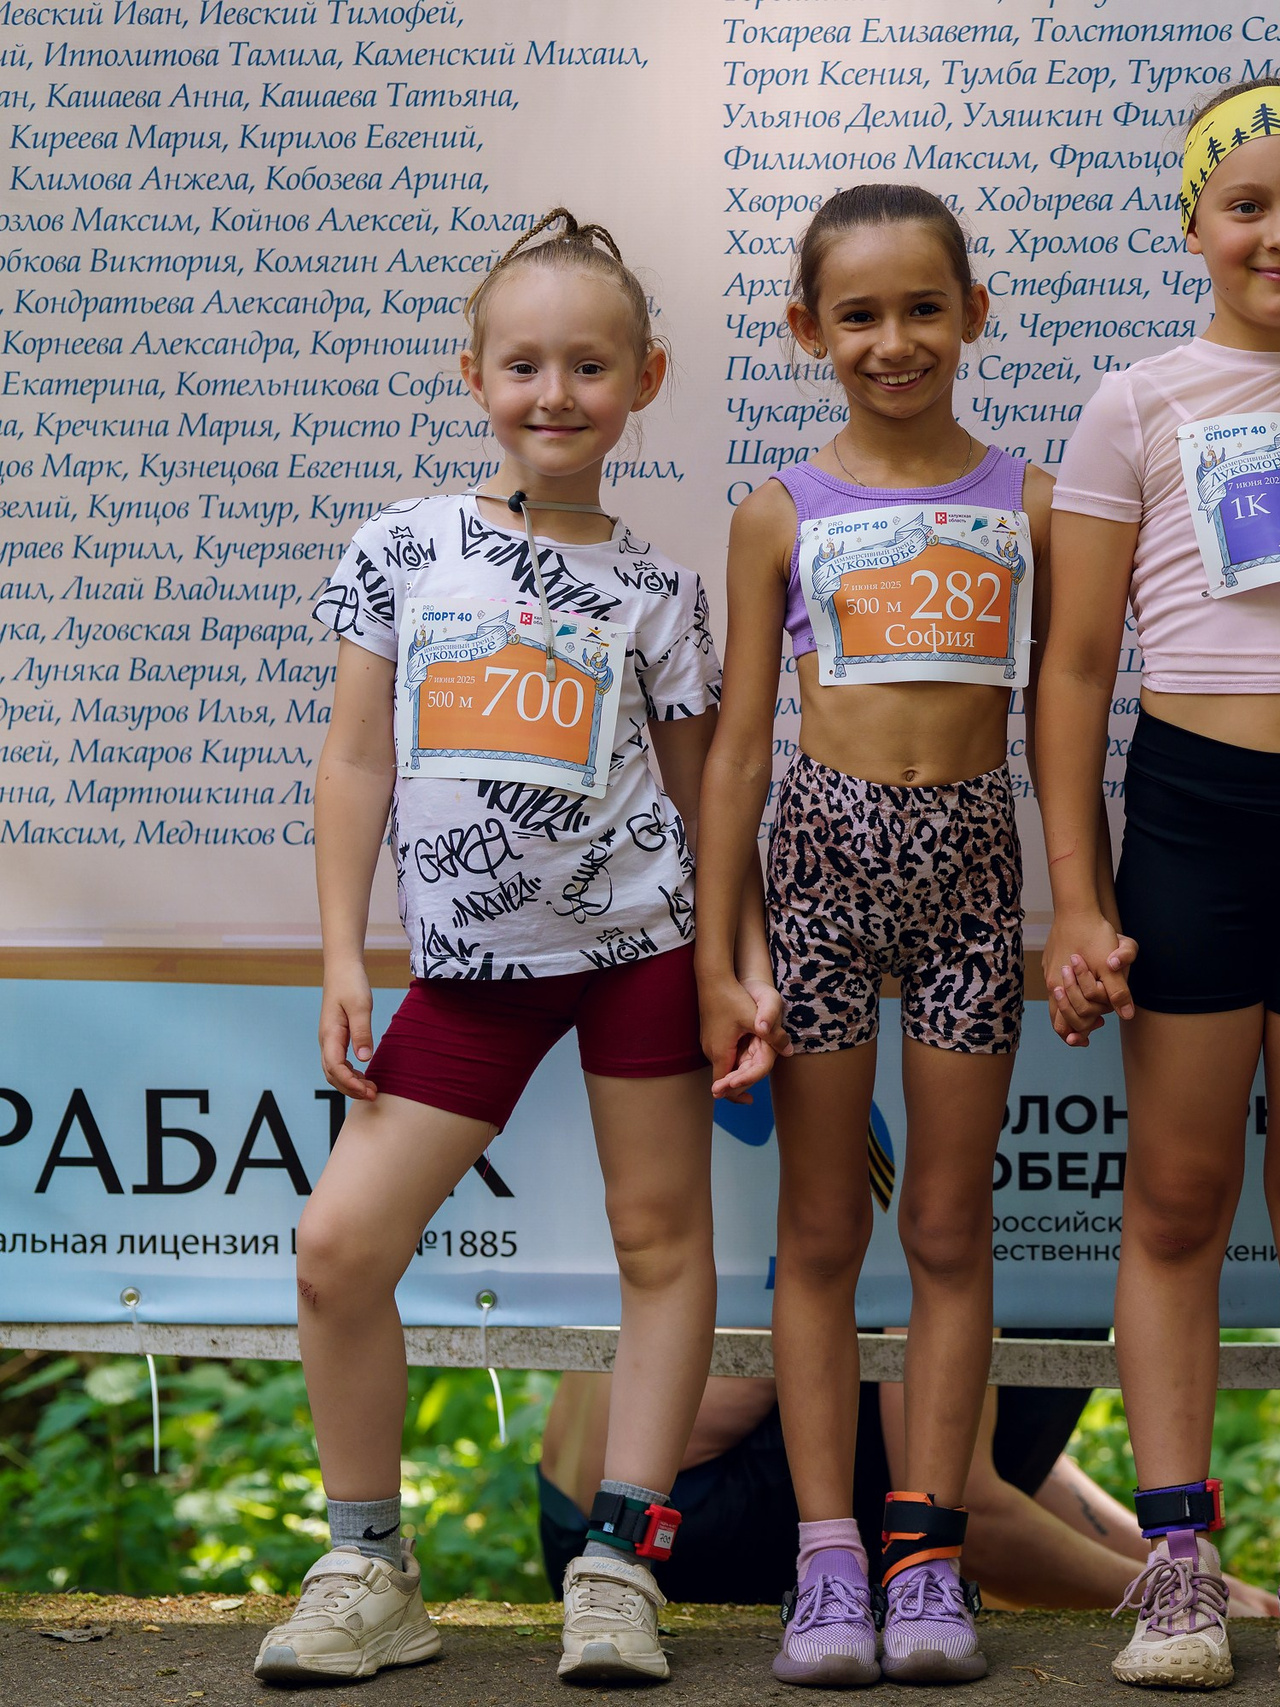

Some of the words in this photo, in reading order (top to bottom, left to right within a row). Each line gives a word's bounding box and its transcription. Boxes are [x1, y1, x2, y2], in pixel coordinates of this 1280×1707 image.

[113, 0, 189, 29] Иван,
[199, 0, 317, 26] Иевский
[327, 0, 464, 33] Тимофей,
[723, 18, 852, 53] Токарева
[860, 17, 1020, 47] Елизавета,
[1031, 17, 1233, 43] Толстопятов
[44, 41, 220, 67] Ипполитова
[228, 41, 343, 70] Тамила,
[354, 40, 516, 67] Каменский
[525, 40, 649, 69] Михаил,
[723, 60, 809, 95] Тороп
[818, 60, 930, 90] Ксения,
[941, 59, 1038, 94] Тумба
[1045, 59, 1117, 94] Егор,
[1128, 58, 1232, 94] Турков
[46, 82, 162, 109] Кашаева
[168, 82, 250, 112] Анна,
[260, 82, 378, 108] Кашаева
[386, 82, 519, 111] Татьяна,
[722, 103, 841, 129] Ульянов
[843, 101, 953, 134] Демид,
[963, 101, 1103, 128] Уляшкин
[10, 124, 119, 158] Киреева
[126, 124, 229, 158] Мария,
[238, 123, 357, 158] Кирилов
[365, 123, 484, 152] Евгений,
[723, 145, 897, 171] Филимонов
[904, 144, 1039, 174] Максим,
[10, 165, 133, 191] Климова
[139, 165, 256, 195] Анжела,
[266, 165, 383, 191] Кобозева
[389, 165, 489, 199] Арина,
[976, 185, 1114, 221] Ходырева
[71, 206, 201, 235] Максим,
[211, 206, 310, 233] Койнов
[316, 206, 439, 235] Алексей,
[1005, 228, 1119, 263] Хромов
[90, 247, 244, 282] Виктория,
[255, 247, 378, 274] Комягин
[987, 270, 1151, 305] Стефания,
[13, 288, 195, 323] Кондратьева
[201, 288, 372, 323] Александра,
[1, 329, 124, 364] Корнеева
[131, 329, 300, 364] Александра,
[1019, 312, 1196, 347] Череповская
[1, 370, 166, 405] Екатерина,
[176, 370, 380, 397] Котельникова
[977, 354, 1082, 389] Сергей,
[35, 411, 170, 446] Кречкина
[177, 412, 281, 446] Мария,
[290, 412, 401, 447] Кристо
[1203, 424, 1220, 432] PRO
[1205, 427, 1248, 441] СПОРТ
[1250, 425, 1266, 435] 40
[41, 452, 129, 487] Марк,
[139, 452, 279, 487] Кузнецова
[288, 453, 403, 483] Евгения,
[1228, 482, 1233, 491] 7
[1236, 480, 1262, 489] июня
[88, 493, 190, 528] Купцов
[198, 493, 300, 528] Тимур,
[827, 522, 870, 536] СПОРТ
[872, 520, 888, 530] 40
[73, 534, 184, 568] Кирилл,
[826, 544, 918, 579] Лукоморье
[60, 575, 144, 601] Лигай
[154, 575, 303, 610] Владимир,
[851, 582, 878, 591] июня
[880, 581, 902, 590] 2025
[910, 569, 1001, 623] 282
[422, 604, 435, 612] PRO
[422, 612, 455, 621] СПОРТ
[457, 612, 473, 622] 40
[846, 597, 880, 615] 500
[886, 602, 902, 613] м
[52, 616, 191, 650] Луговская
[201, 616, 314, 651] Варвара,
[885, 623, 975, 653] София
[417, 641, 496, 668] Лукоморье
[12, 656, 120, 691] Луняка
[128, 656, 247, 691] Валерия,
[428, 675, 433, 683] 7
[456, 675, 476, 684] 2025
[427, 690, 454, 709] 500
[459, 696, 473, 709] м
[481, 665, 584, 728] 700
[71, 697, 189, 732] Мазуров
[197, 698, 276, 727] Илья,
[69, 738, 193, 772] Макаров
[201, 738, 313, 773] Кирилл,
[65, 779, 275, 813] Мартюшкина
[0, 819, 126, 848] Максим,
[133, 819, 276, 846] Медников
[116, 1232, 279, 1260] лицензия
